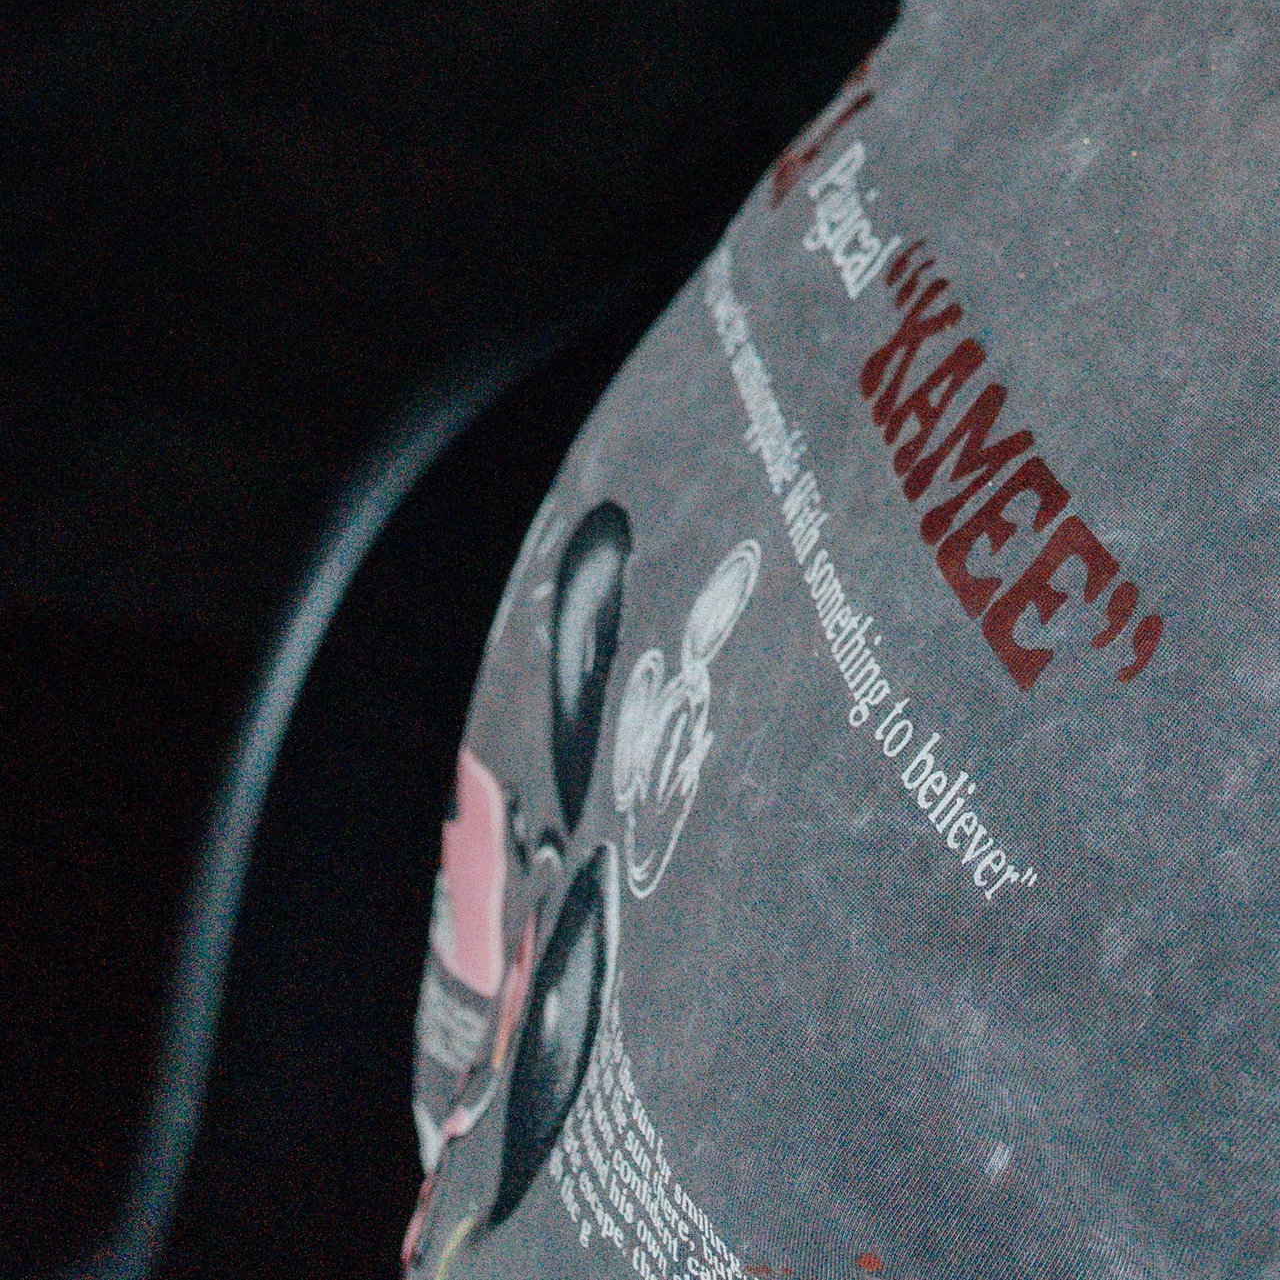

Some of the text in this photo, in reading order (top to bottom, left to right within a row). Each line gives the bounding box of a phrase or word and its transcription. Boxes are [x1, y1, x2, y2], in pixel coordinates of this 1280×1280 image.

[804, 548, 891, 728] something
[874, 697, 914, 758] to
[624, 1129, 652, 1181] sun
[609, 1172, 635, 1225] his
[636, 1218, 668, 1280] own
